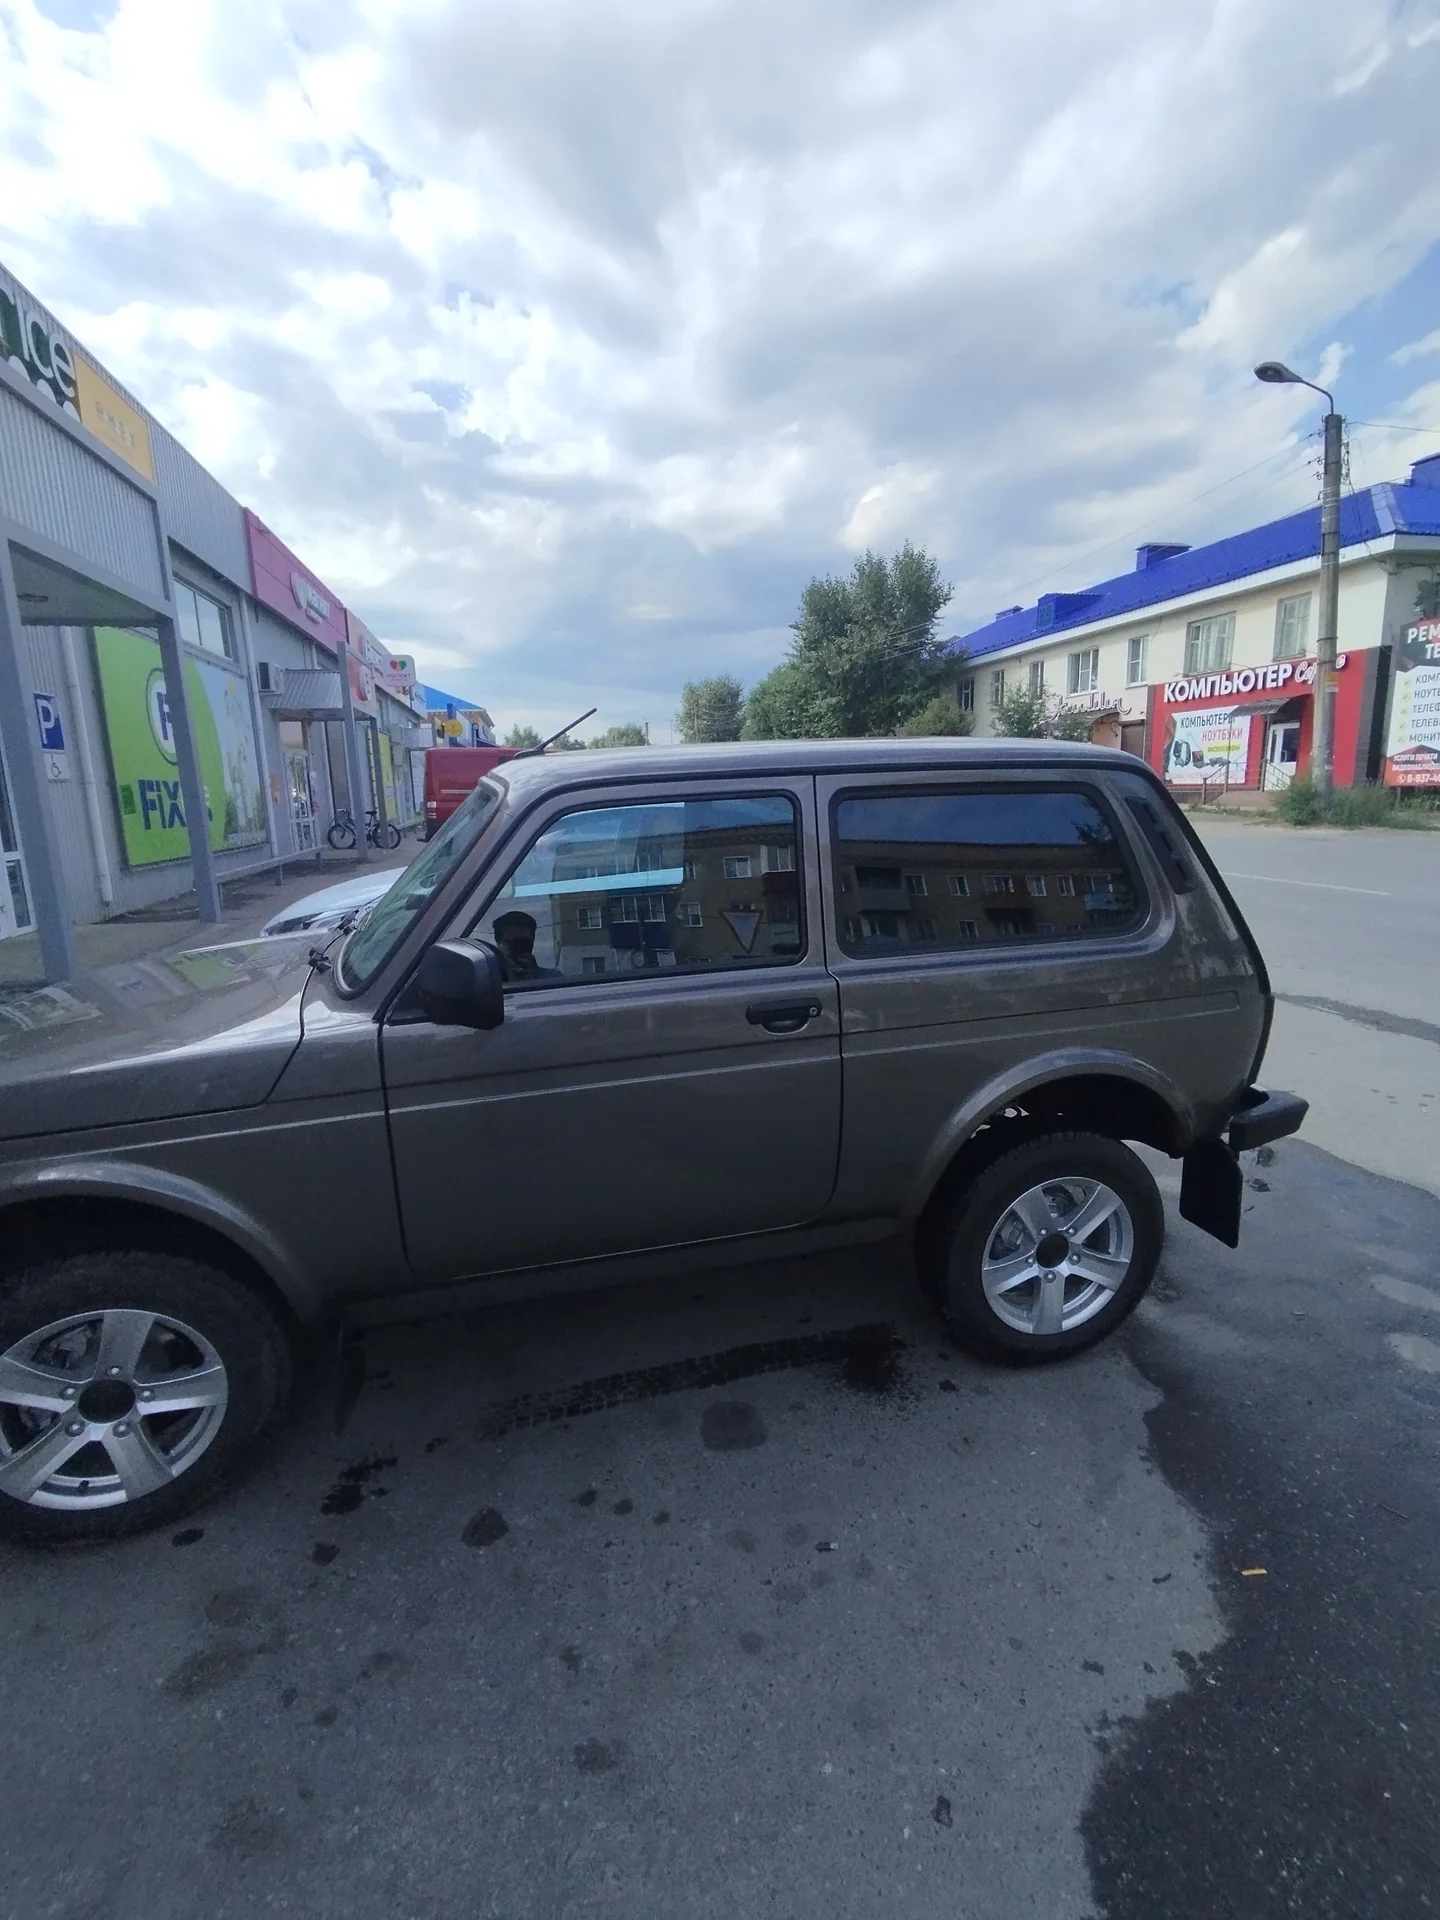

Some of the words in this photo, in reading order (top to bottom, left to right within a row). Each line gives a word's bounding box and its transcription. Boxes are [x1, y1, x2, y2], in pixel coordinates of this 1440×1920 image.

[1163, 663, 1293, 704] КОМПЬЮТЕР
[37, 699, 55, 745] P
[1180, 712, 1236, 729] КОМПЬЮТЕРЫ
[1202, 727, 1243, 742] НОУТБУКИ
